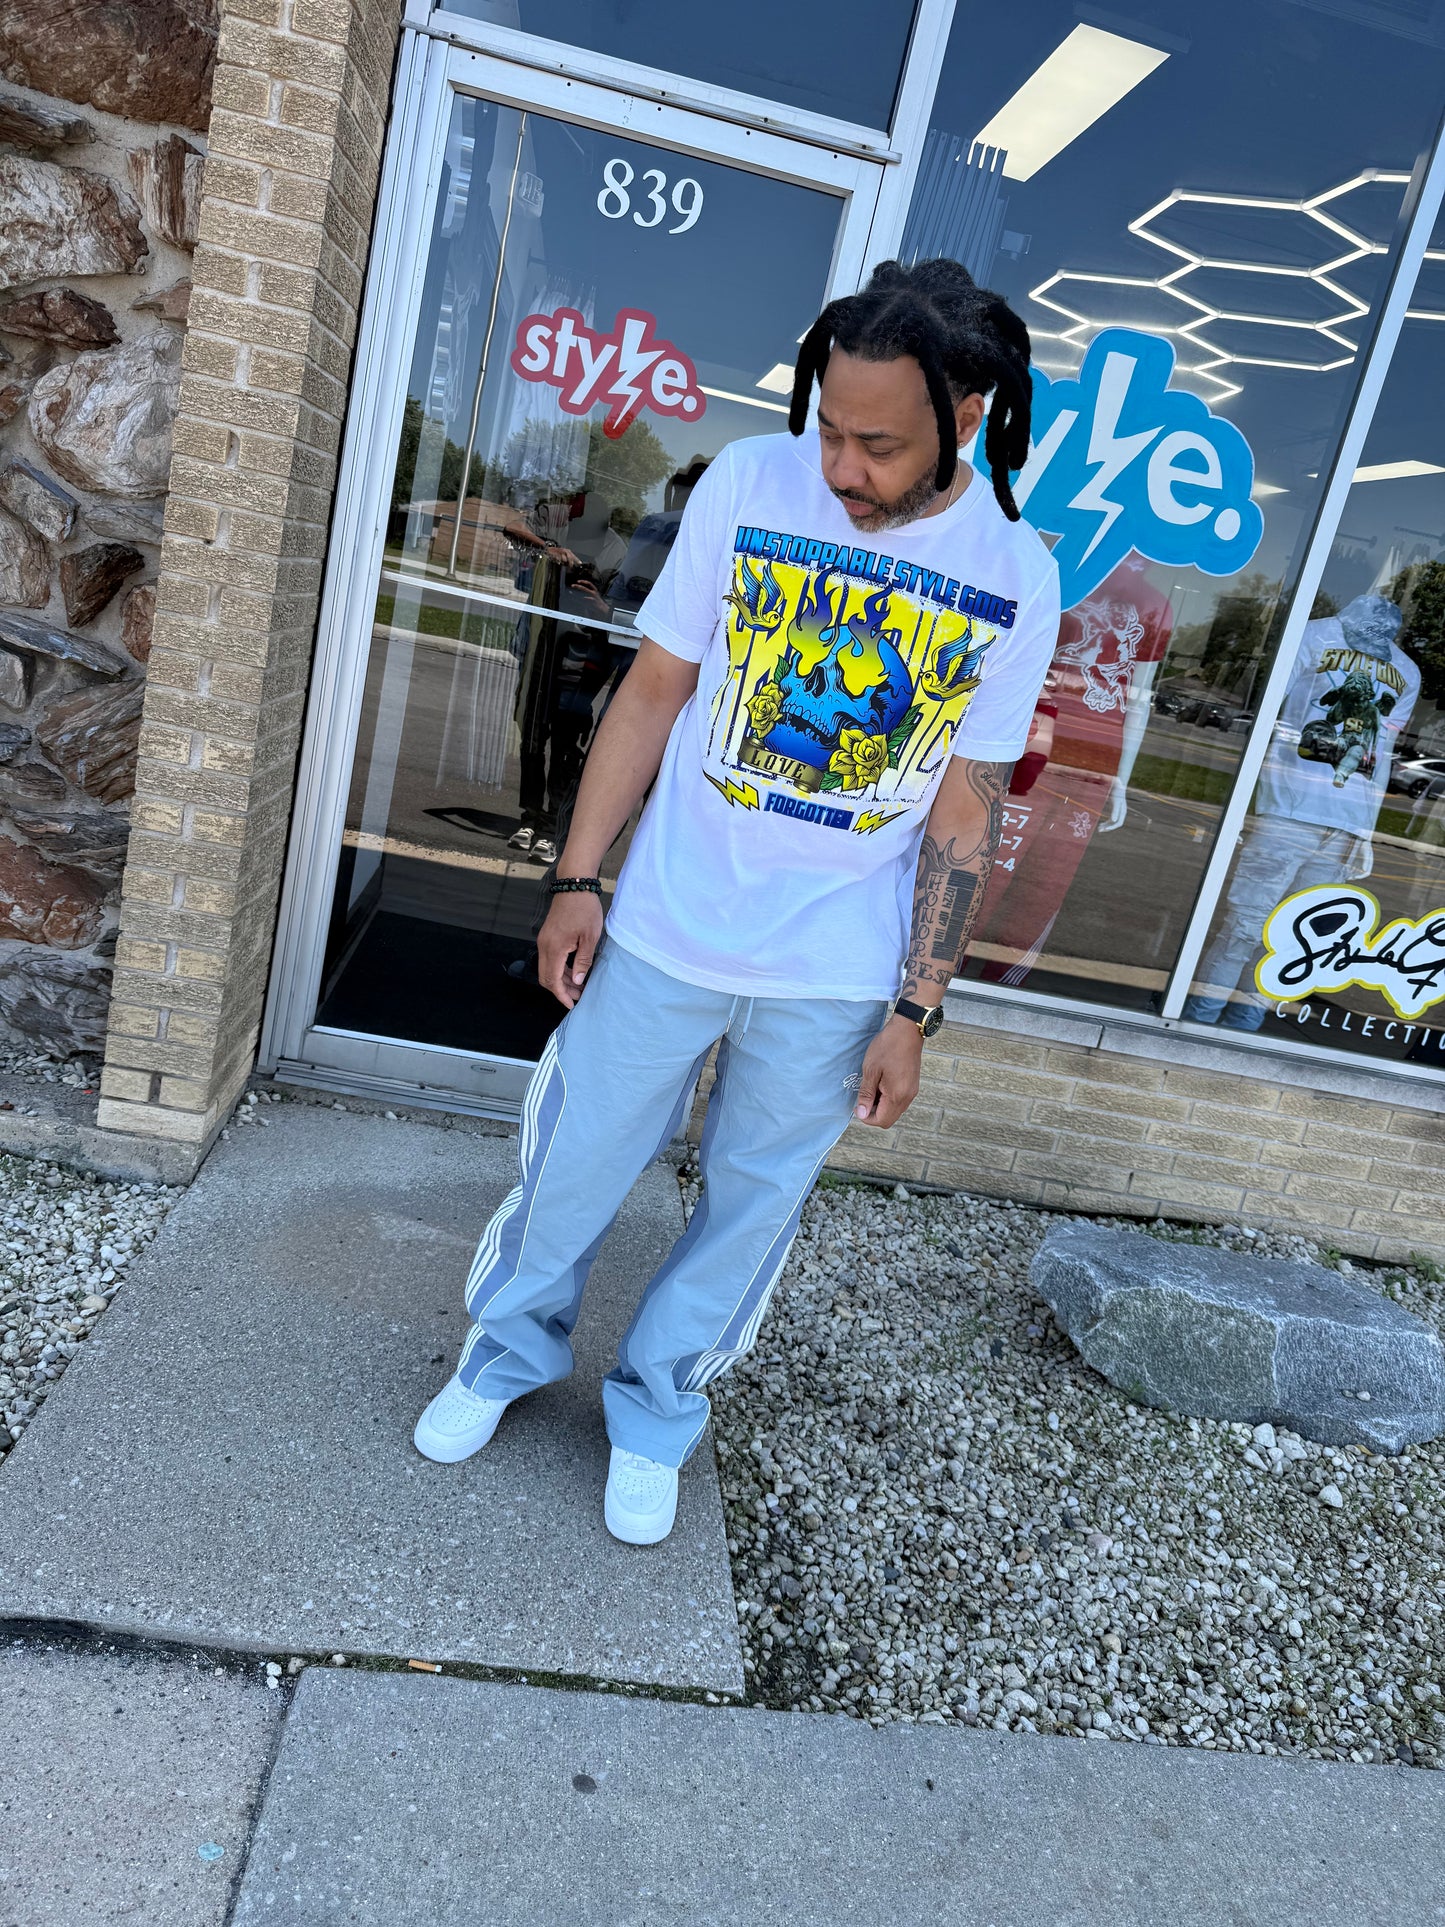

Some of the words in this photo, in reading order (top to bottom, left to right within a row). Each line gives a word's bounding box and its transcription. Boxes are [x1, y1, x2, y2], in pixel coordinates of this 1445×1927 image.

[597, 158, 704, 234] 839
[734, 525, 894, 583] UNSTOPPABLE
[892, 561, 960, 605] STYLE
[959, 586, 1018, 629] GODS
[751, 750, 807, 779] LOVE
